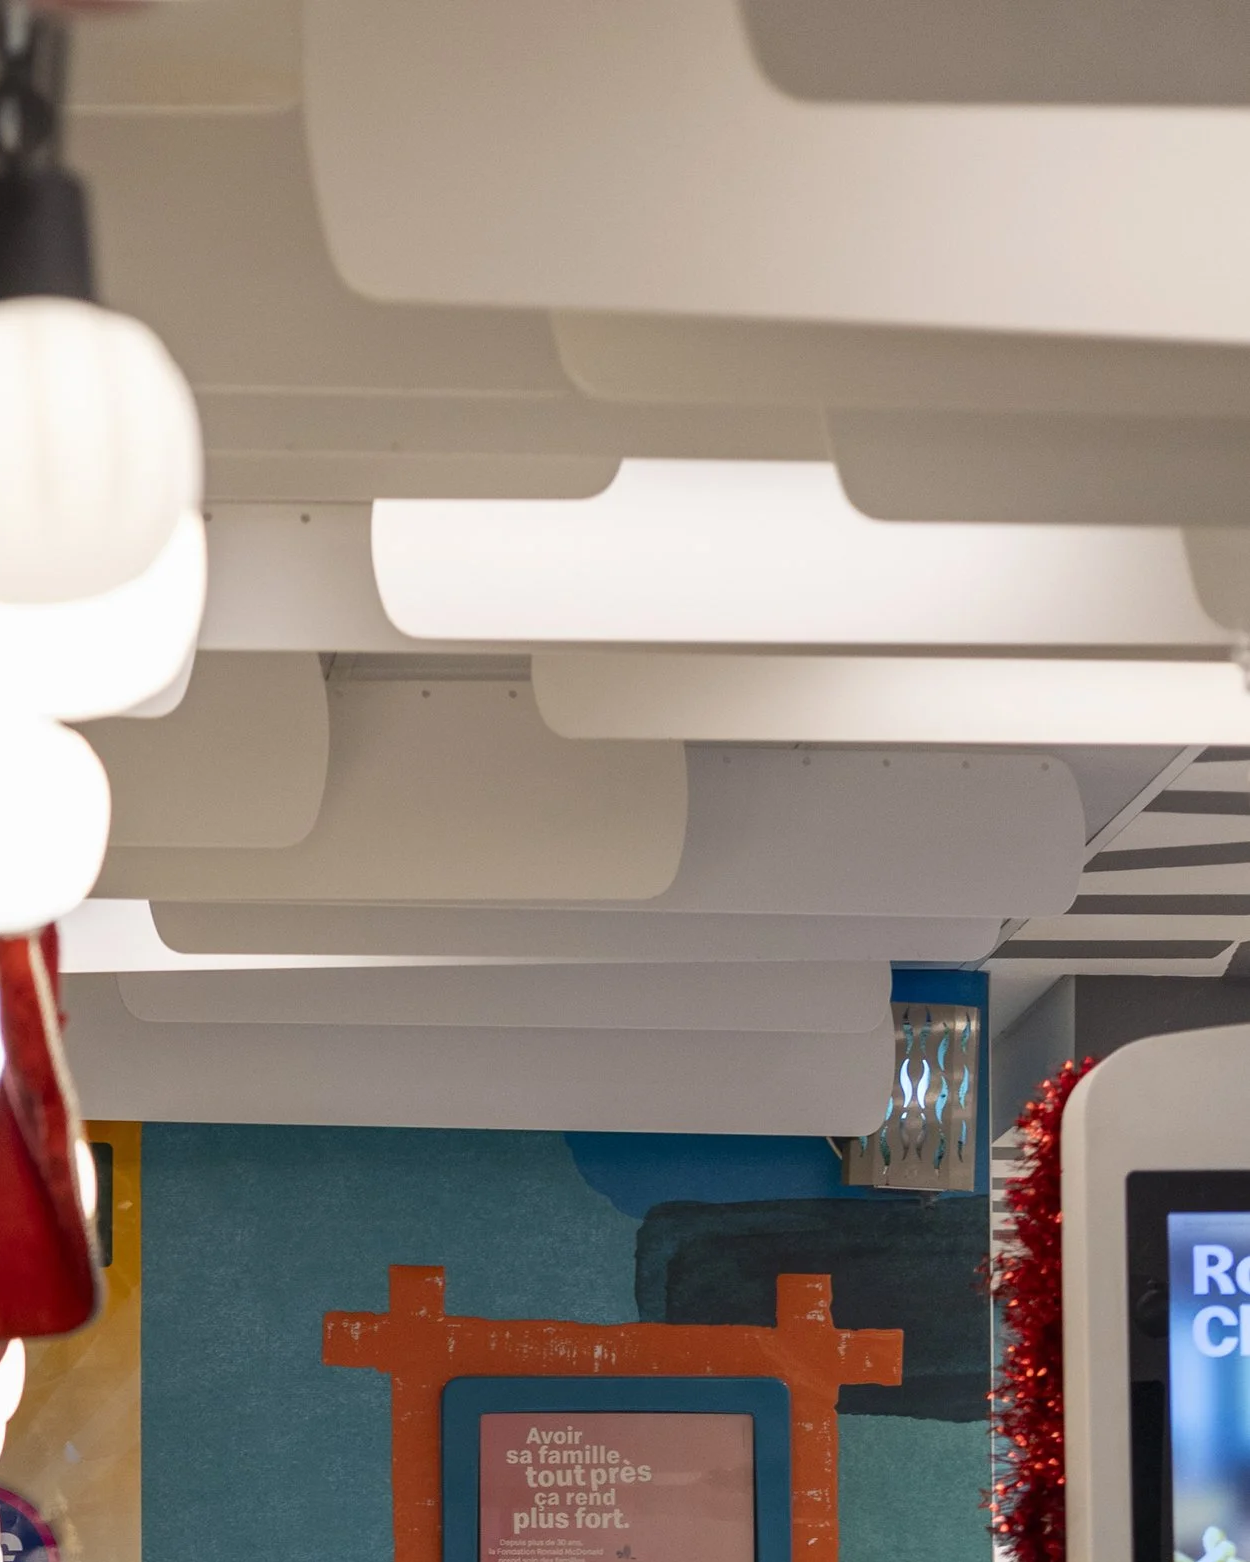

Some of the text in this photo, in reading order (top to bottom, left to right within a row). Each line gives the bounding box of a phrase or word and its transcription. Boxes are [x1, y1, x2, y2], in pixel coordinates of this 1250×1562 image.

[525, 1425, 583, 1445] Avoir
[505, 1444, 620, 1465] sa famille
[525, 1458, 652, 1492] tout près
[534, 1488, 616, 1512] ça rend
[513, 1506, 630, 1535] plus fort.
